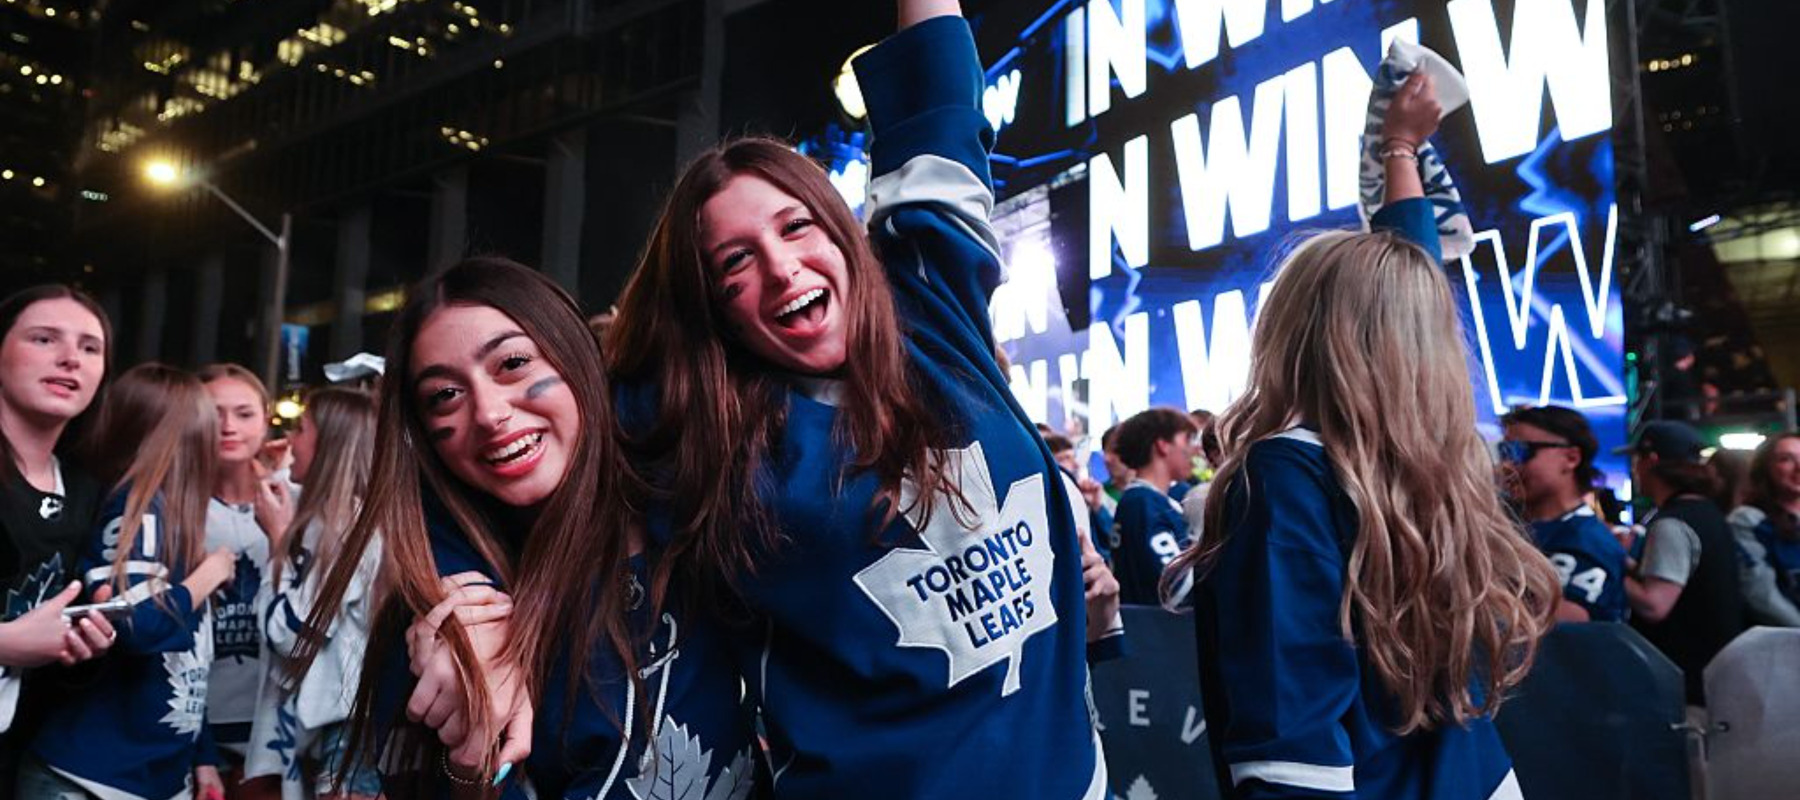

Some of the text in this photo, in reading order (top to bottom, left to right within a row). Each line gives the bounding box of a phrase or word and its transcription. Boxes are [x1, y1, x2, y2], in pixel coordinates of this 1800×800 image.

[906, 520, 1033, 603] TORONTO
[944, 557, 1032, 622] MAPLE
[964, 590, 1035, 649] LEAFS
